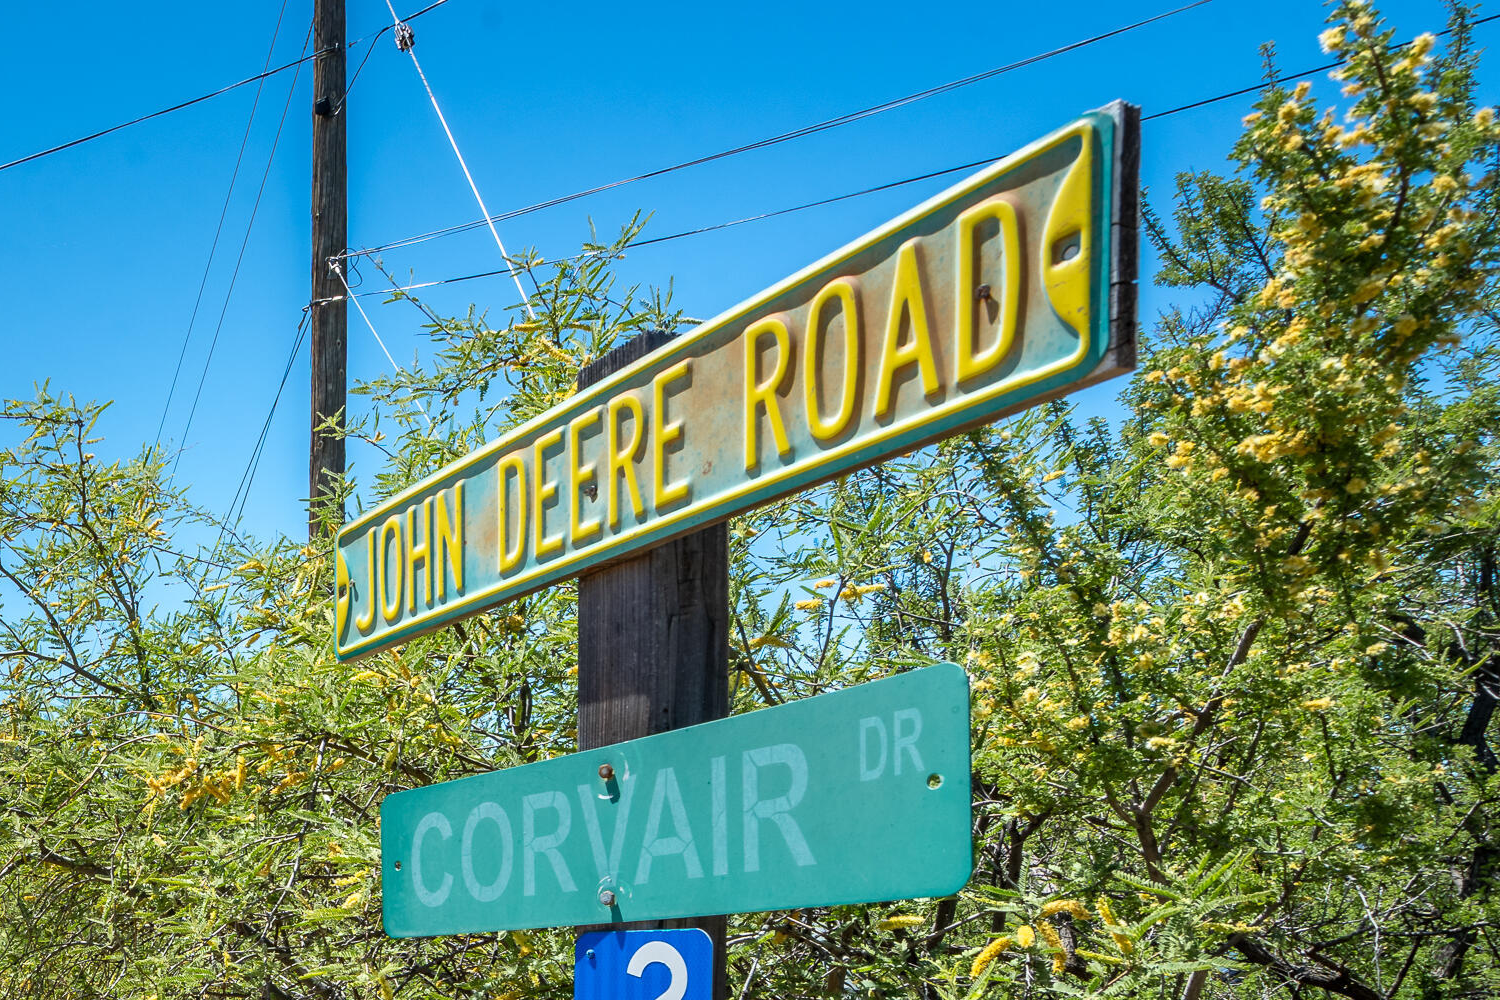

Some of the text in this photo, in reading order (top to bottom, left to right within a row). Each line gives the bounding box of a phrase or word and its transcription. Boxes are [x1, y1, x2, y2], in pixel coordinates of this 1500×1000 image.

[356, 198, 1023, 633] JOHN DEERE ROAD
[411, 707, 925, 908] CORVAIR DR
